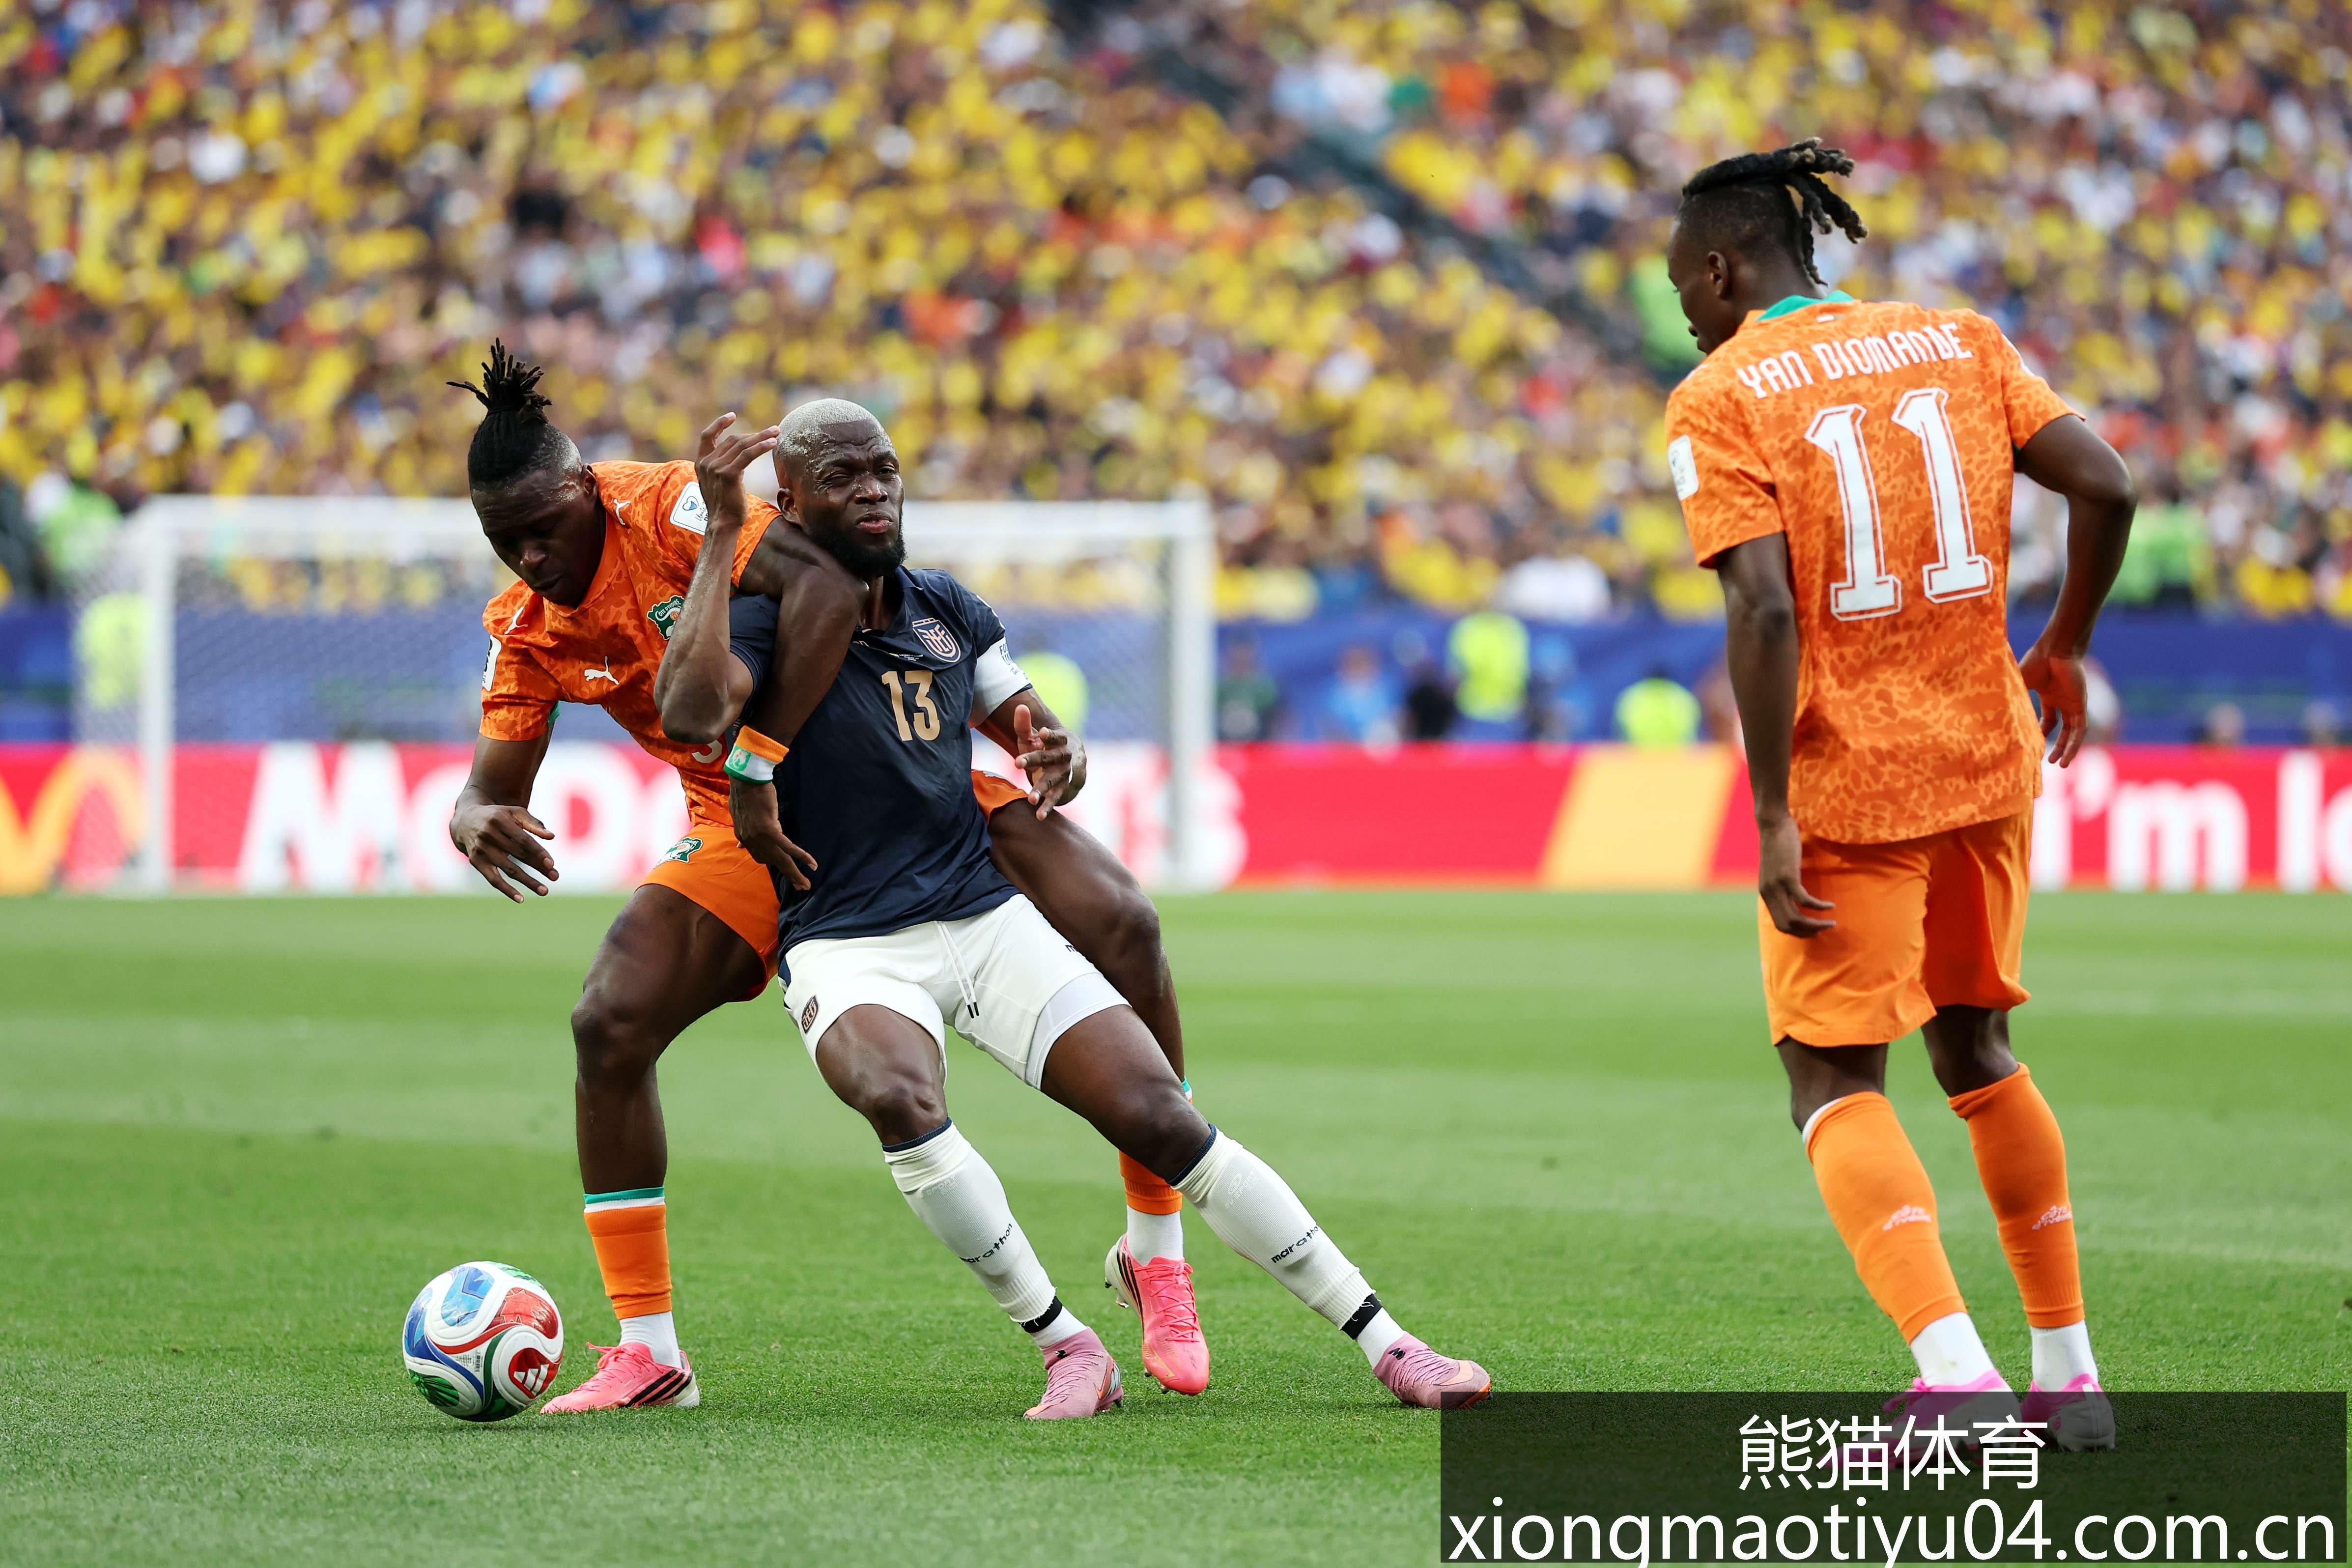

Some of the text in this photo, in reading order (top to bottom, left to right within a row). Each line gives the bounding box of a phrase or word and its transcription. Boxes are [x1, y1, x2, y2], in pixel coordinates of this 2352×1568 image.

[1736, 322, 1973, 399] YAN DIOMANDE
[1804, 387, 1994, 622] 11
[881, 670, 940, 741] 13
